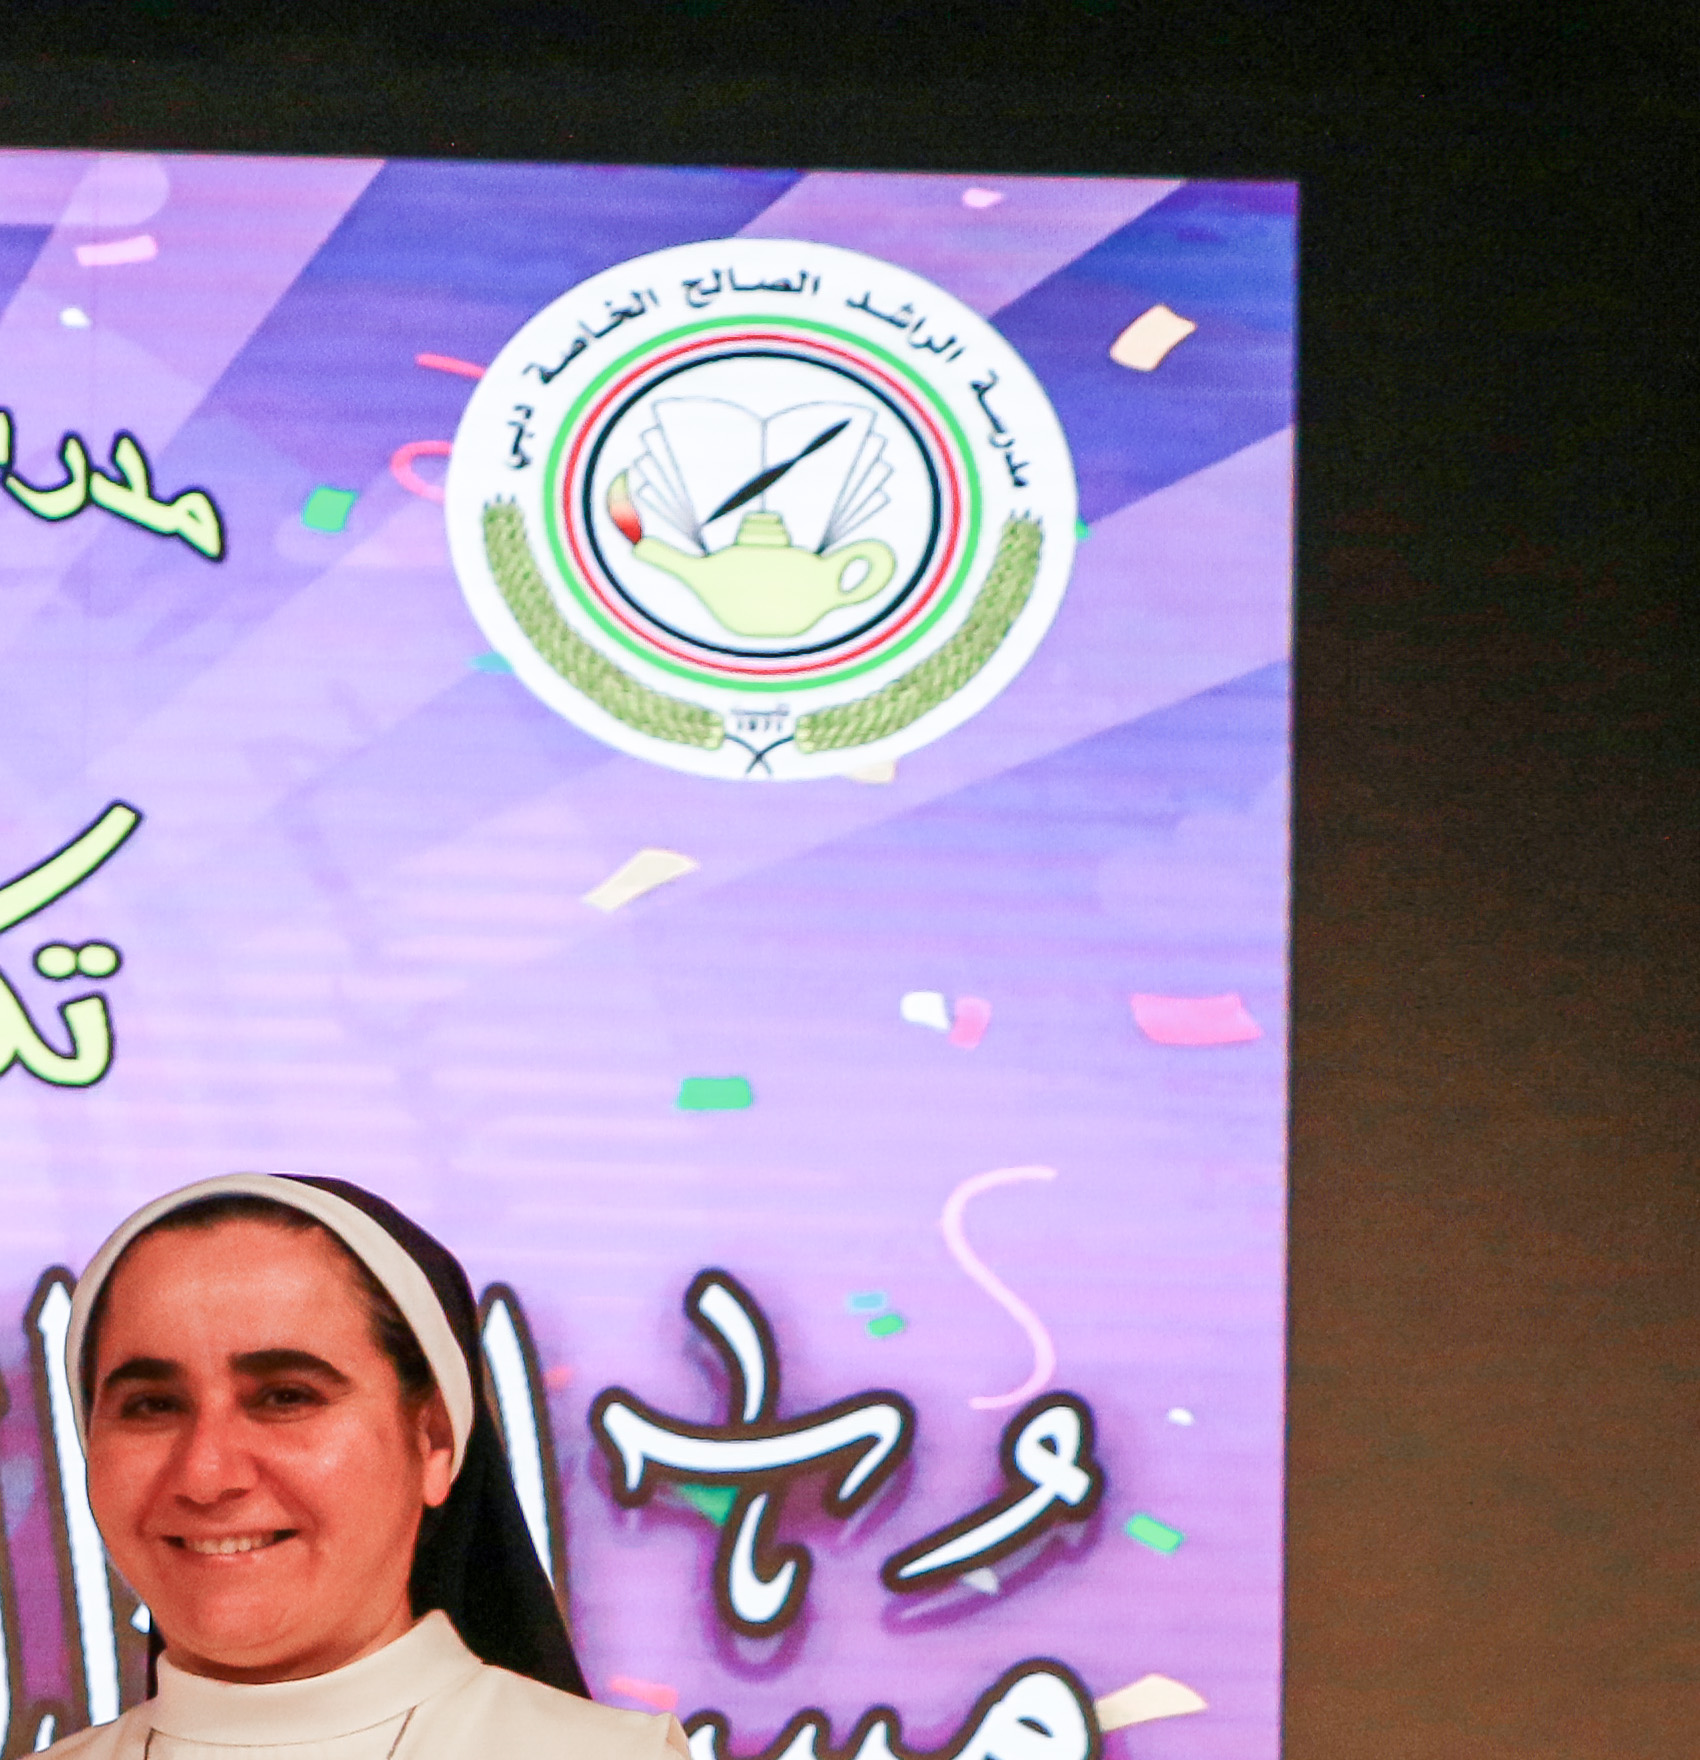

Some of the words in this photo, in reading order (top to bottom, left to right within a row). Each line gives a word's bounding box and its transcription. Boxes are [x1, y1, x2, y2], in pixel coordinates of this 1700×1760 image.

[680, 265, 822, 309] الصالح
[845, 291, 967, 364] الراشد
[520, 287, 662, 386] الخاصة
[968, 368, 1031, 488] مدرسة
